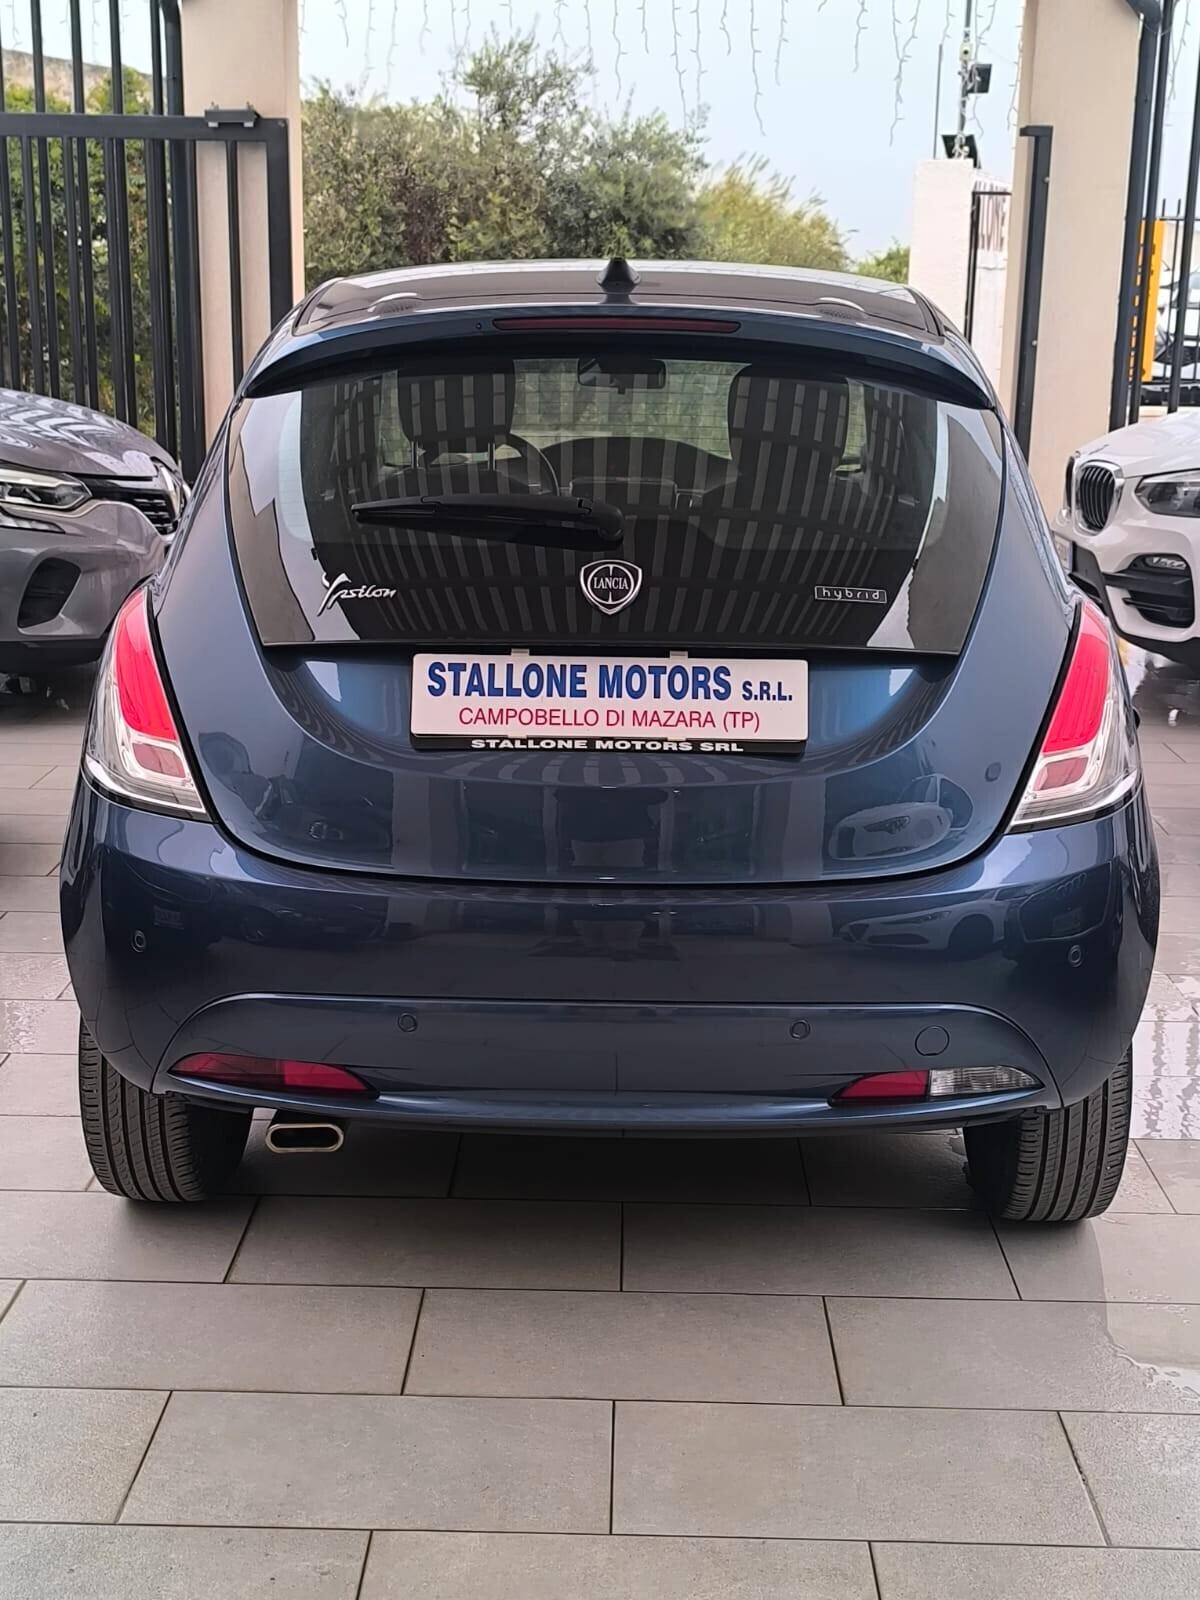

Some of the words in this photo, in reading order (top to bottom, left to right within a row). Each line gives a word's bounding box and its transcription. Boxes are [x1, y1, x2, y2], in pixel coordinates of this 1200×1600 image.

[593, 577, 629, 590] LANCIA
[317, 573, 397, 616] Ypsilon
[822, 587, 880, 600] hybrid
[427, 661, 588, 698] STALLONE
[599, 664, 732, 701] MOTORS
[742, 680, 793, 701] S.R.L.
[459, 707, 599, 727] CAMPOBELLO
[606, 709, 625, 727] DI
[632, 710, 716, 729] MAZARA
[723, 711, 760, 733] (TP)
[471, 739, 588, 749] STALLONE
[595, 740, 693, 751] MOTORS
[700, 742, 744, 752] SRL
